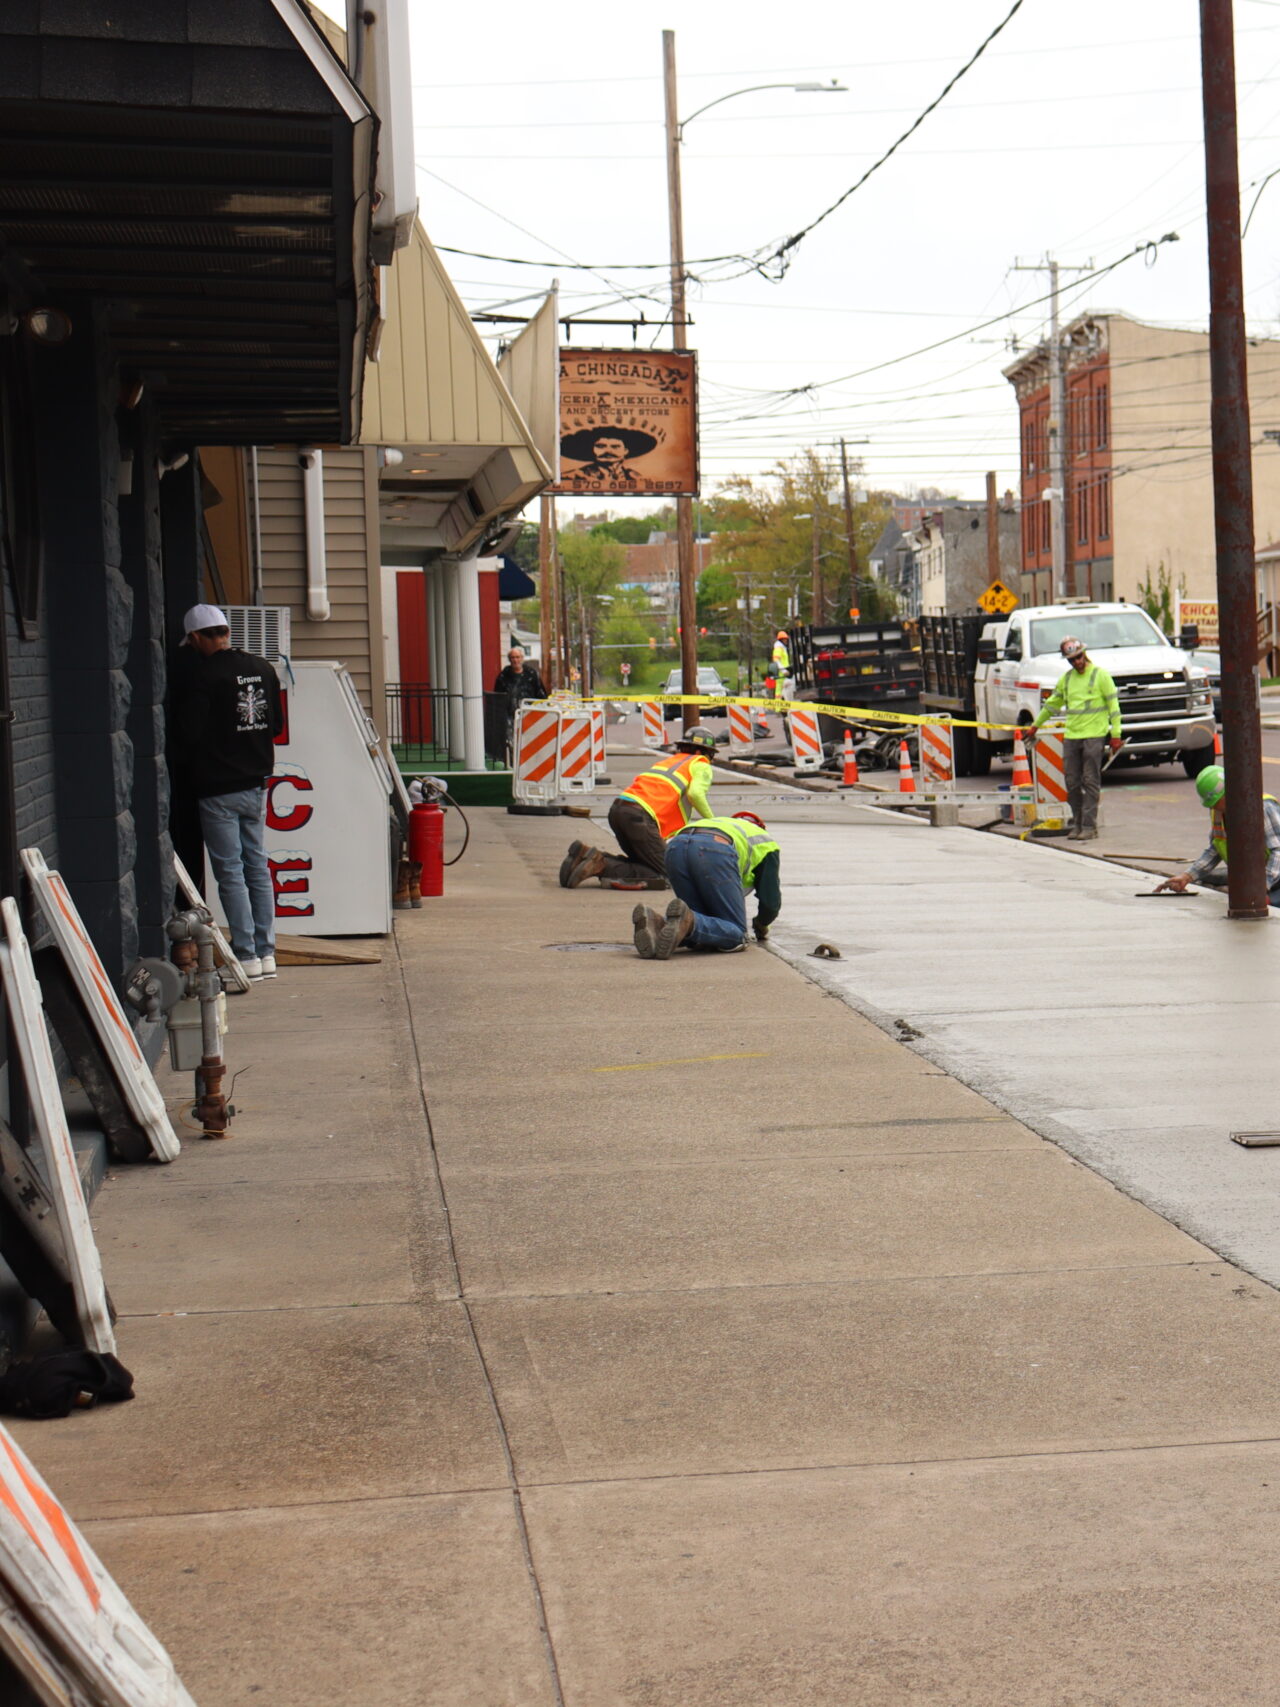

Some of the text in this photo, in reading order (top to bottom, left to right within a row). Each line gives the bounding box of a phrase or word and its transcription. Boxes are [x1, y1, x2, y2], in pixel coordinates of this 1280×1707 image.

[577, 363, 666, 384] CHINGADA
[613, 397, 689, 405] MEXICANA
[566, 407, 586, 415] AND
[591, 407, 634, 415] GROCERY
[639, 408, 670, 416] STORE
[1181, 603, 1217, 616] CHICA
[236, 675, 262, 685] Groove
[763, 700, 791, 708] CAUTION
[818, 706, 846, 714] CAUTION
[872, 711, 900, 720] CAUTION
